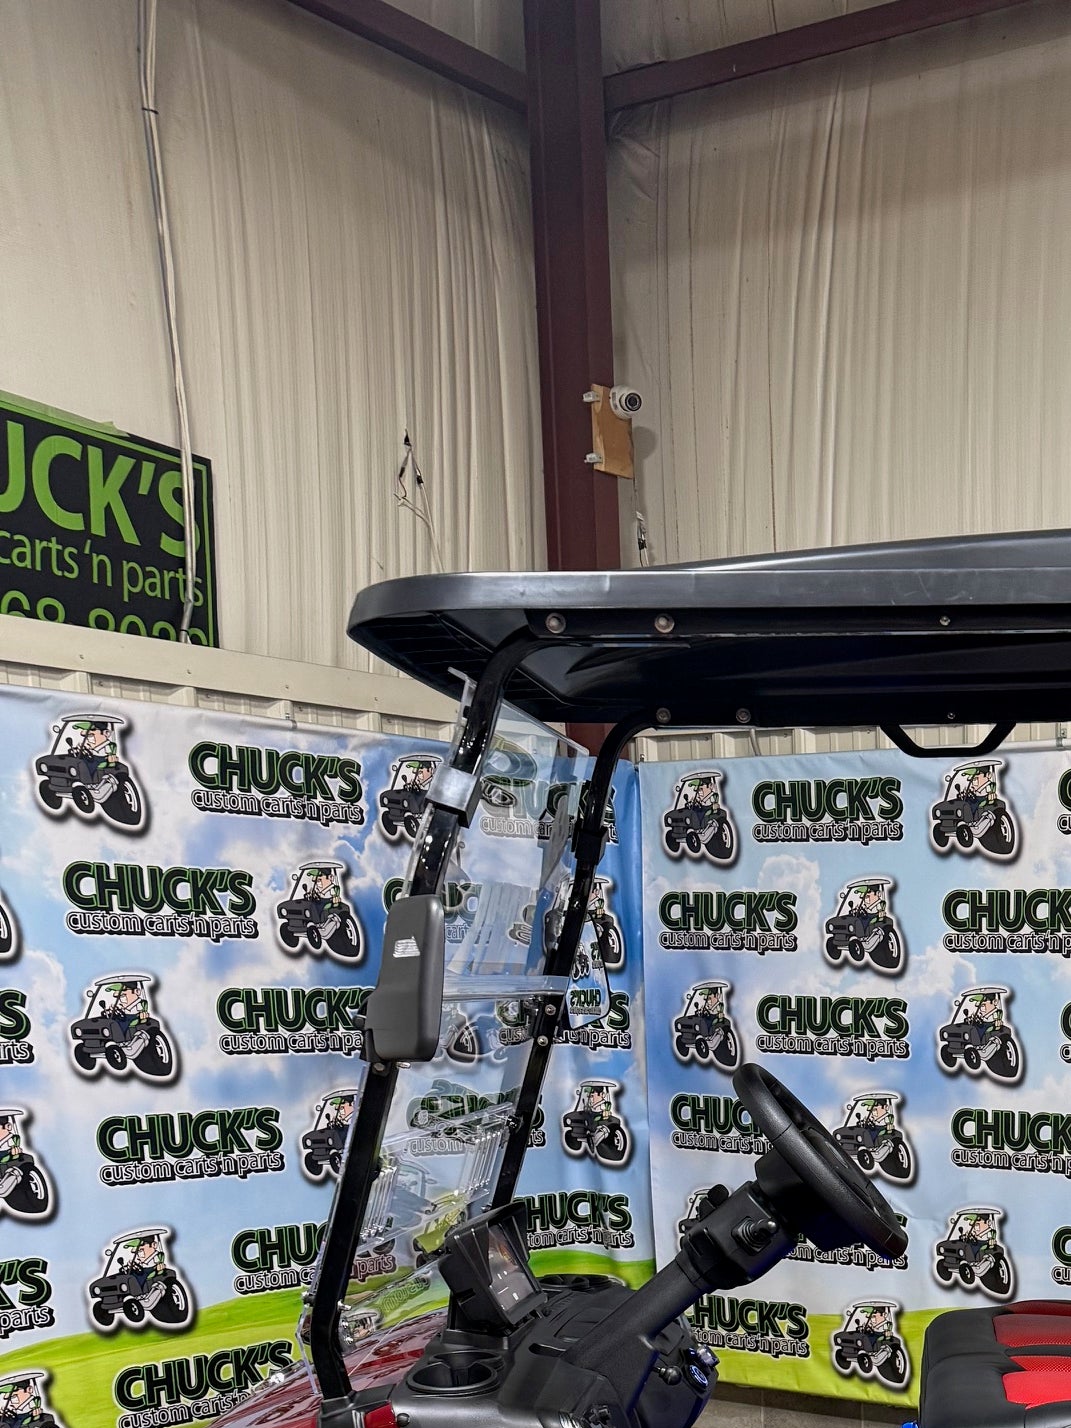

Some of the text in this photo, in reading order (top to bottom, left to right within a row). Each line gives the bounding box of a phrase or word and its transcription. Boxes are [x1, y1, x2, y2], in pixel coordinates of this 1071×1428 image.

[189, 741, 362, 802] CHUCK'S
[191, 790, 258, 813] custom
[319, 803, 362, 823] parts
[752, 778, 903, 821] CHUCK'S
[752, 822, 807, 840] custom
[861, 820, 902, 845] parts
[63, 861, 256, 917] CHUCK'S
[67, 912, 140, 934] custom
[209, 917, 256, 939] parts
[659, 891, 797, 931] CHUCK'S
[660, 931, 708, 949] custom
[758, 932, 797, 954] parts
[944, 932, 1004, 953] custom
[216, 988, 374, 1032] CHUCK'
[757, 995, 911, 1037] CHUCK'S
[220, 1033, 286, 1053] custom
[590, 1029, 631, 1049] parts
[757, 1034, 813, 1054] custom
[867, 1038, 909, 1059] parts
[97, 1108, 283, 1162] CHUCK'S
[672, 1132, 718, 1151] custom
[101, 1155, 171, 1183] custom
[238, 1152, 282, 1177] parts
[951, 1148, 1010, 1169] custom
[514, 1190, 632, 1231] HUCK'S
[235, 1270, 299, 1293] custom
[688, 1295, 809, 1340] HUCK'S
[771, 1338, 809, 1358] parts
